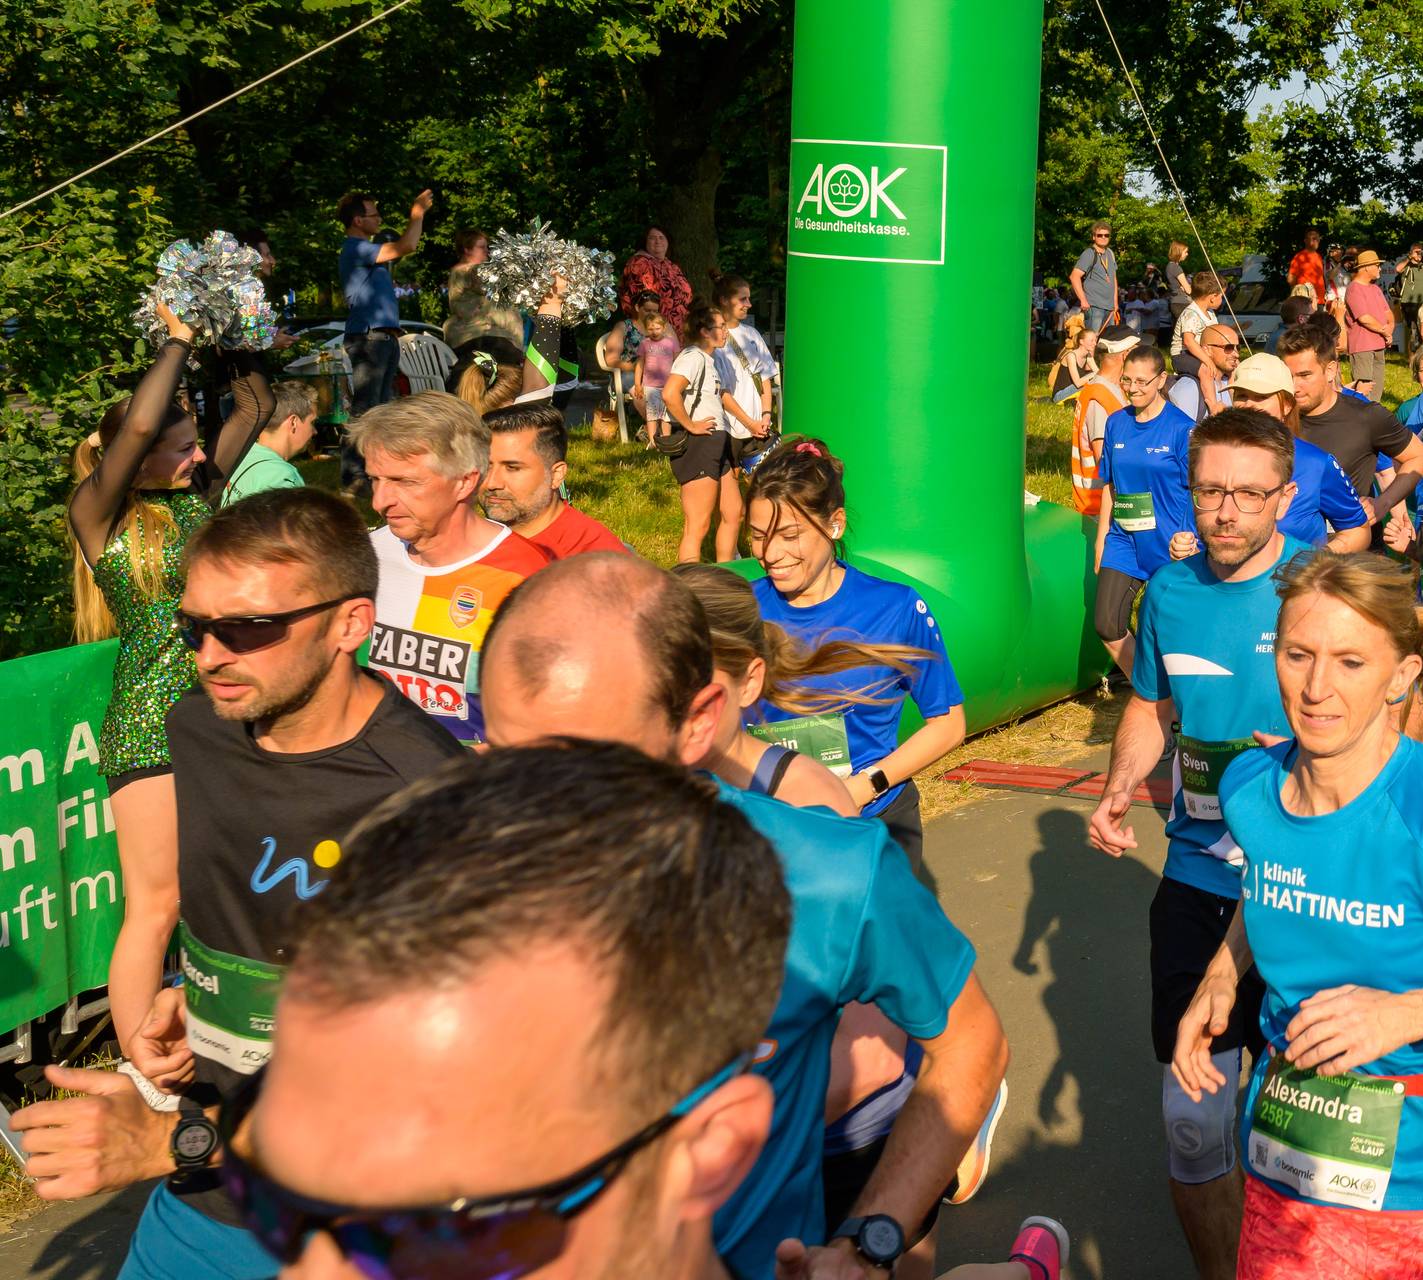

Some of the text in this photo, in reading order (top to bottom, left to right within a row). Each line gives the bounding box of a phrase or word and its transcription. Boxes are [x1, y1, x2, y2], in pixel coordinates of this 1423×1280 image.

[796, 162, 908, 220] AOK
[794, 217, 911, 236] Die Gesundheitskasse.
[369, 624, 464, 679] FABER
[1255, 644, 1277, 653] HER
[1182, 752, 1210, 772] Sven
[1263, 861, 1307, 887] klinik
[1262, 883, 1405, 928] HATTINGEN
[1264, 1073, 1364, 1125] Alexandra
[1260, 1100, 1294, 1131] 2587
[1360, 1145, 1386, 1157] LAUF
[1280, 1159, 1361, 1191] bonamic AOK
